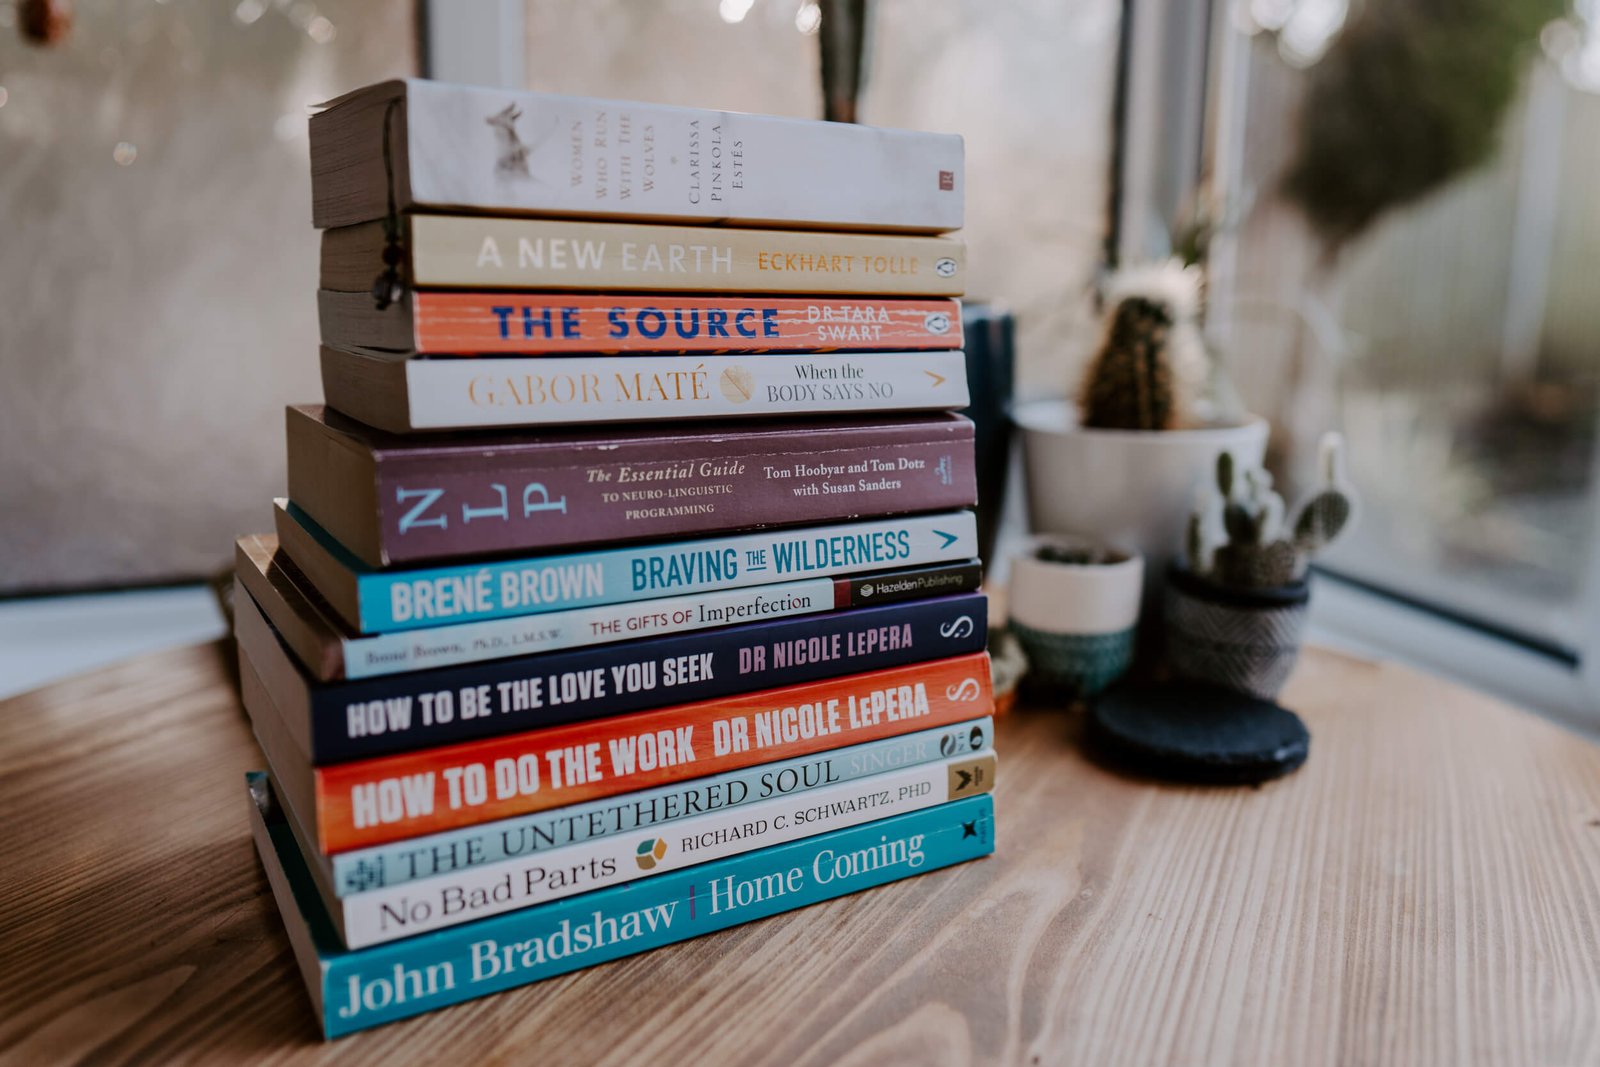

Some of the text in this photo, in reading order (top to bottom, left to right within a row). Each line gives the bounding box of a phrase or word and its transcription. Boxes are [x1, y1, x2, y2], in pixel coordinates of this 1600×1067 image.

[572, 120, 582, 187] WOMEN
[618, 113, 632, 200] WITH THE
[643, 125, 655, 192] WOLVES
[689, 120, 700, 204] CLARISSA
[711, 124, 722, 202] PINKOLA
[731, 140, 744, 190] ESTÉS
[595, 158, 607, 200] WHO
[477, 236, 732, 274] A NEW EARTH
[758, 251, 919, 274] ECKHART TOLLE
[491, 306, 780, 339] THE SOURCE
[807, 305, 890, 323] DR TARA
[817, 325, 882, 341] SWART
[468, 363, 710, 406] GABOR MATÉ
[767, 382, 894, 402] BODY SAYS NO
[795, 363, 864, 380] When the
[586, 460, 745, 482] The Essential Guide
[763, 466, 790, 479] Tom
[794, 462, 845, 480] Hoobyar
[847, 461, 868, 473] and
[869, 459, 896, 472] Tom
[898, 457, 925, 470] Dotz
[793, 479, 901, 497] with Susan Sanders
[601, 484, 733, 502] TO NEURO-LINGUISTIC
[625, 504, 715, 520] PROGRAMMING
[631, 529, 910, 592] BRAVING THE WILDERNESS
[390, 562, 604, 623] BRENÉ BROWN
[589, 593, 812, 635] THE GIFTS OF Imperfection
[739, 646, 766, 675] DR
[773, 634, 841, 669] NICOLE
[346, 652, 715, 739] HOW TO BE THE LOVE YOU SEEK
[713, 716, 750, 757] DR
[754, 699, 841, 750] NICOLE
[352, 725, 696, 829] HOW TO DO THE WORK
[850, 742, 928, 775] SINGER
[401, 759, 840, 879] THE UNTETHERED SOUL
[682, 781, 931, 853] RICHARD C. SCHWARTZ, PHD
[379, 856, 617, 931] No Bad Parts
[709, 834, 925, 916] Home Coming
[338, 900, 680, 1019] John Bradshaw
